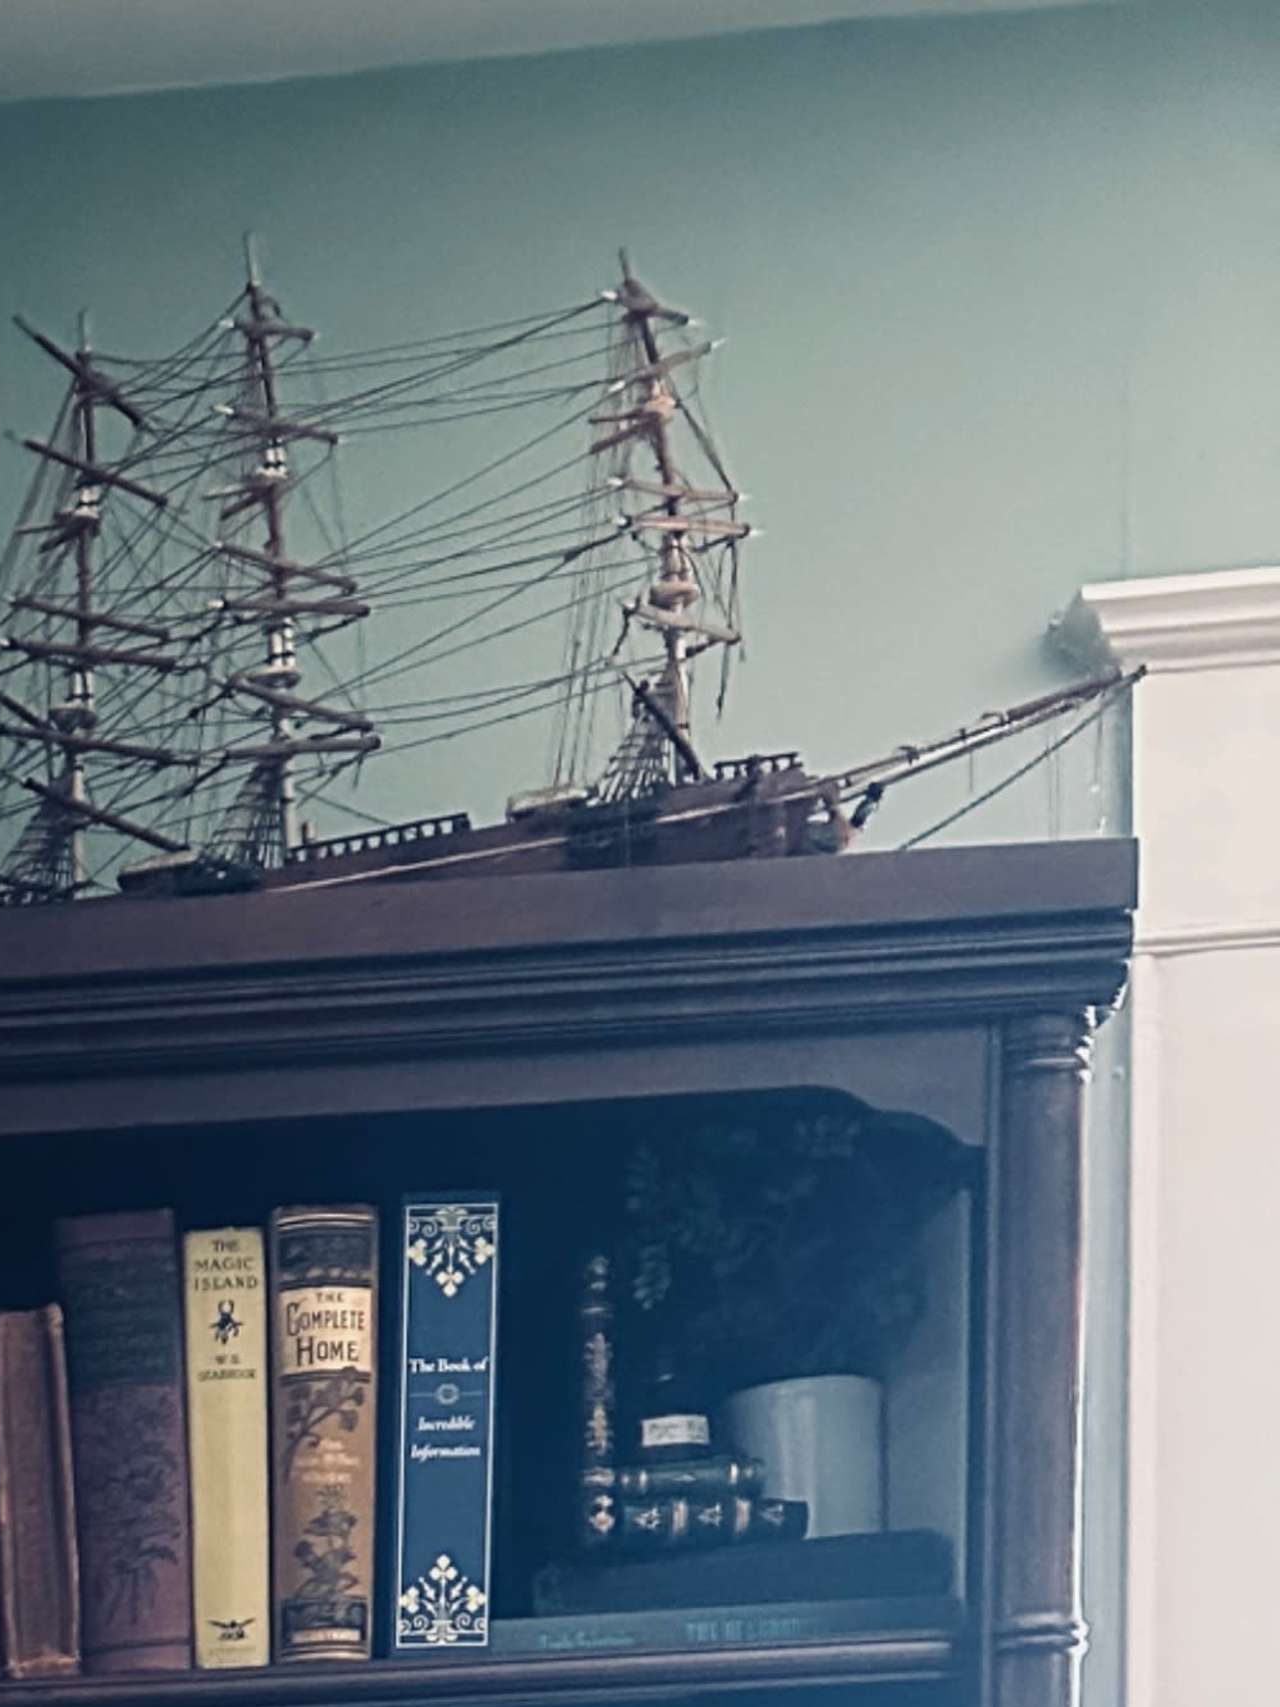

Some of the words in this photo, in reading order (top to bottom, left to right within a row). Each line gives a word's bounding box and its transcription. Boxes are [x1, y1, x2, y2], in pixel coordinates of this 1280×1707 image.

[211, 1239, 239, 1253] THE
[193, 1256, 255, 1272] MAGIC
[193, 1275, 258, 1292] ISLAND
[315, 1291, 345, 1303] THE
[295, 1335, 360, 1367] HOME
[408, 1358, 436, 1373] The
[438, 1357, 471, 1373] Book
[472, 1355, 490, 1372] of
[417, 1415, 476, 1431] Incredible
[410, 1444, 482, 1463] Information
